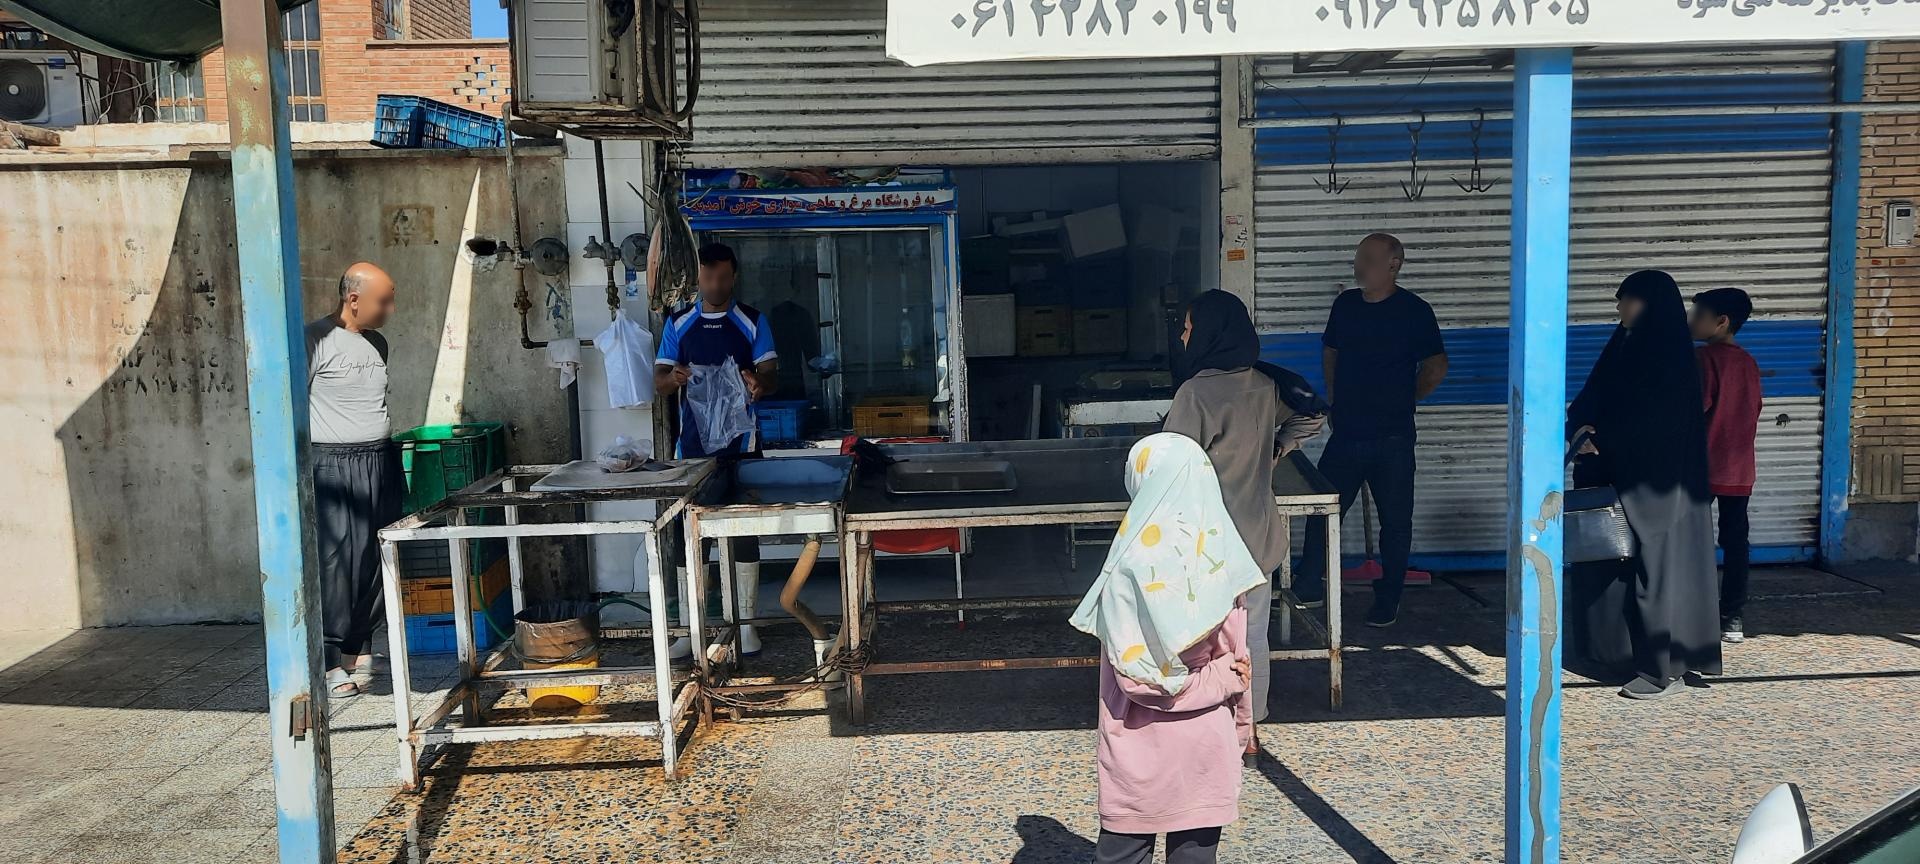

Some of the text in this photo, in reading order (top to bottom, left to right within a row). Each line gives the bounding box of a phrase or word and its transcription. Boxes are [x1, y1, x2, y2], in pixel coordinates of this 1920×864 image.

[951, 0, 1015, 38] ۰۶۱
[1152, 0, 1237, 35] ۰۱۹۹
[729, 197, 762, 214] خوش
[805, 194, 836, 213] ماهی
[838, 198, 846, 212] و
[848, 193, 873, 211] مرغ
[875, 191, 922, 210] فروشگاه
[924, 194, 936, 206] به
